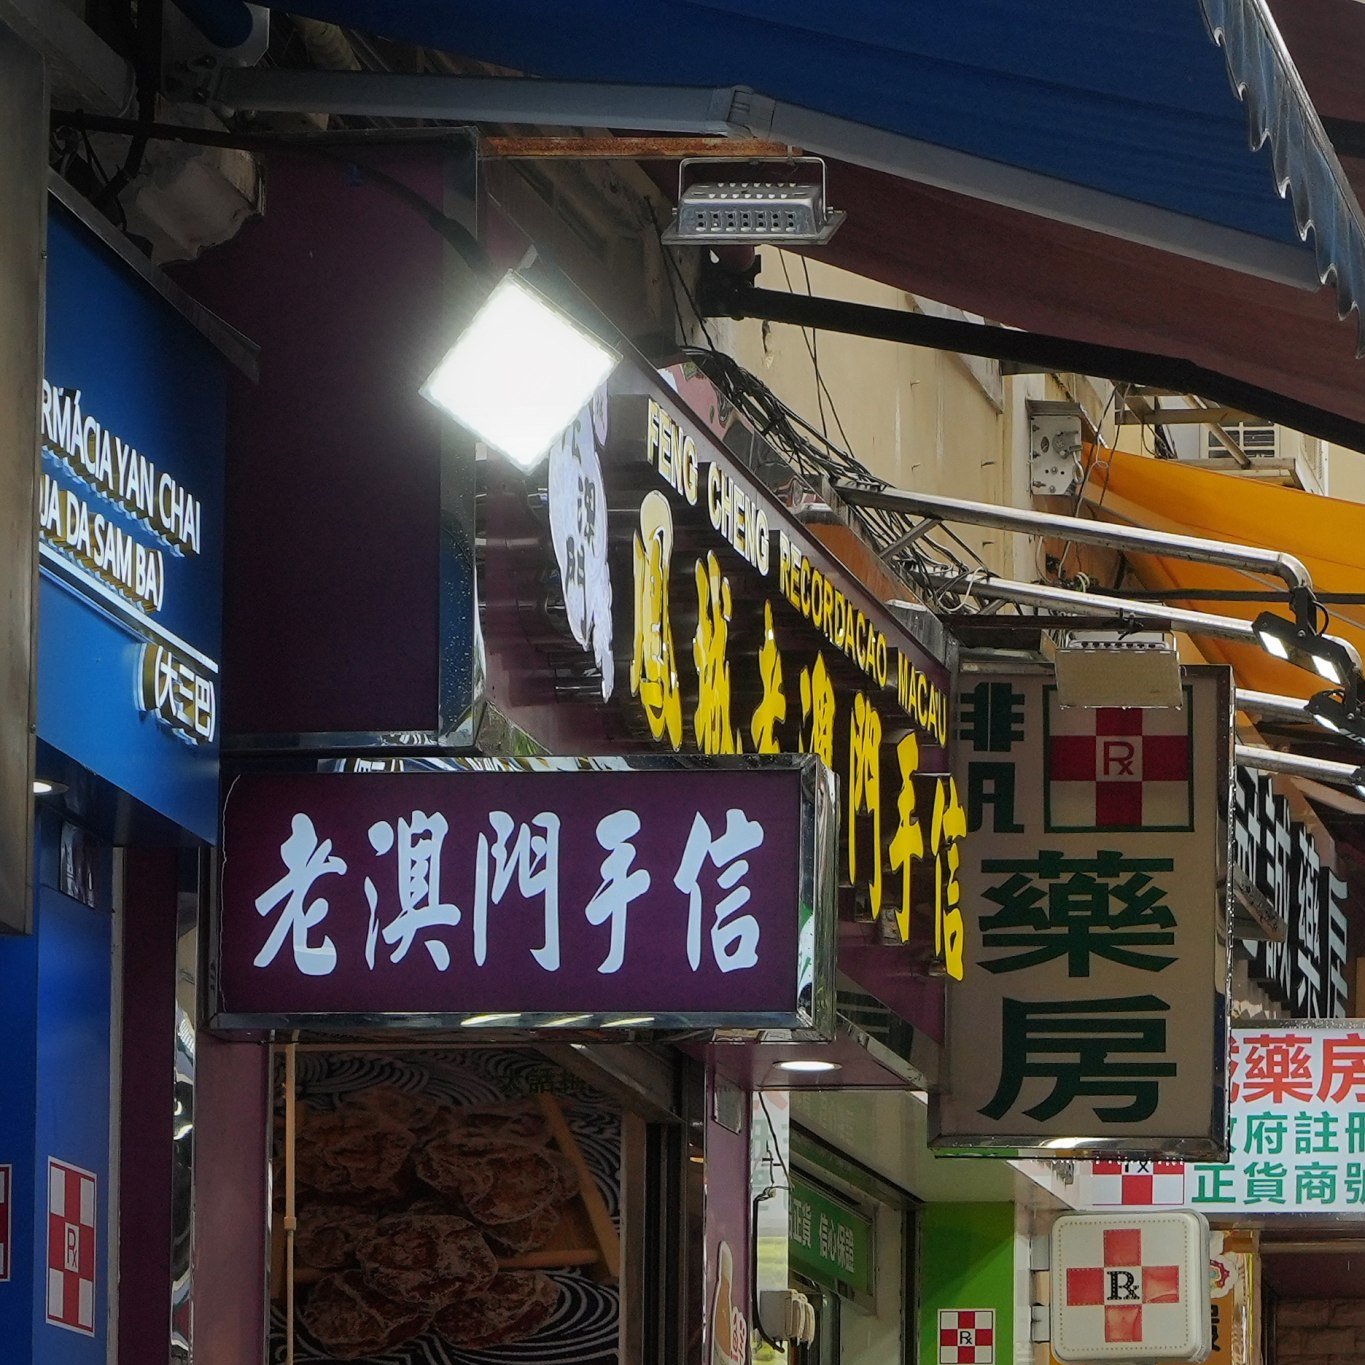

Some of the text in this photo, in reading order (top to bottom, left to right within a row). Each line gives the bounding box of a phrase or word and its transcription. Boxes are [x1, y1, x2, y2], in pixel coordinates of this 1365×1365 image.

[66, 490, 91, 557] DA
[93, 514, 132, 587] SAM
[135, 542, 164, 612] BA)
[115, 436, 155, 518] YAN
[159, 473, 200, 554] CHAI
[647, 399, 948, 748] FENG CHENG RECORDACAO MACAU
[253, 809, 764, 975] 老澳門手信
[976, 850, 1179, 1123] 藥房
